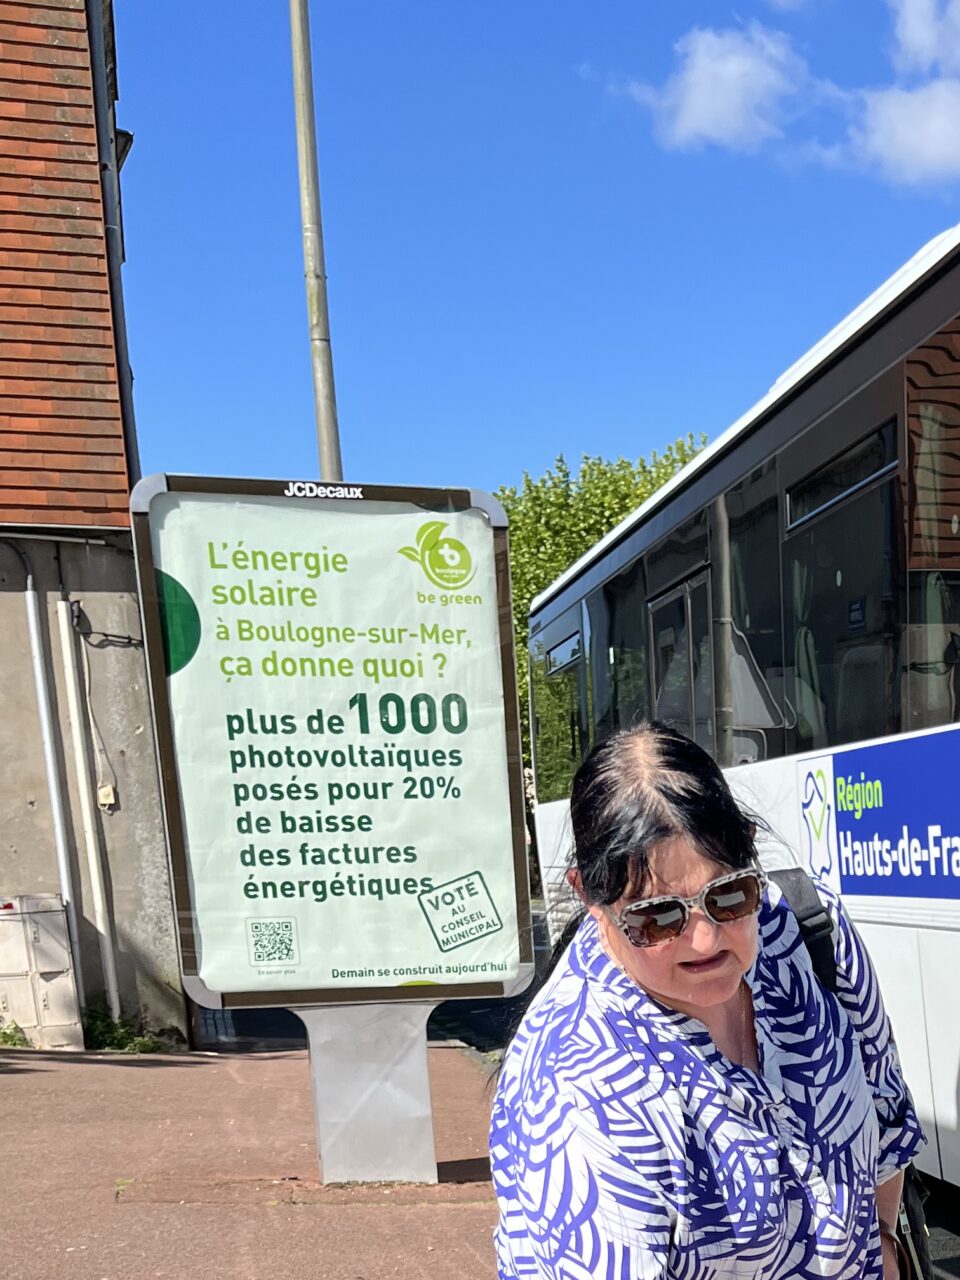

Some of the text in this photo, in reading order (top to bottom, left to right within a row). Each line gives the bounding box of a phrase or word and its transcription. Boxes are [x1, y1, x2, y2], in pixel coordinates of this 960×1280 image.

[284, 482, 363, 499] JCDecaux
[207, 540, 349, 578] L'énergie
[211, 579, 318, 608] solaire
[416, 591, 482, 607] be green
[215, 617, 472, 649] à Boulogne-sur-Mer,
[219, 651, 448, 683] ça donne quoi ?
[226, 692, 469, 741] plus de 1000
[229, 743, 464, 774] photovoltaïques
[233, 775, 462, 806] posés pour 20%
[836, 772, 884, 820] Région
[236, 810, 373, 834] de baisse
[240, 843, 418, 867] des factures
[243, 872, 434, 903] énergétiques
[427, 877, 479, 911] VOTÉ
[441, 910, 487, 933] CONSEIL
[451, 904, 466, 917] AU
[441, 918, 499, 948] MUNICIPAL
[331, 961, 508, 979] Demain se construit aujourd'hui
